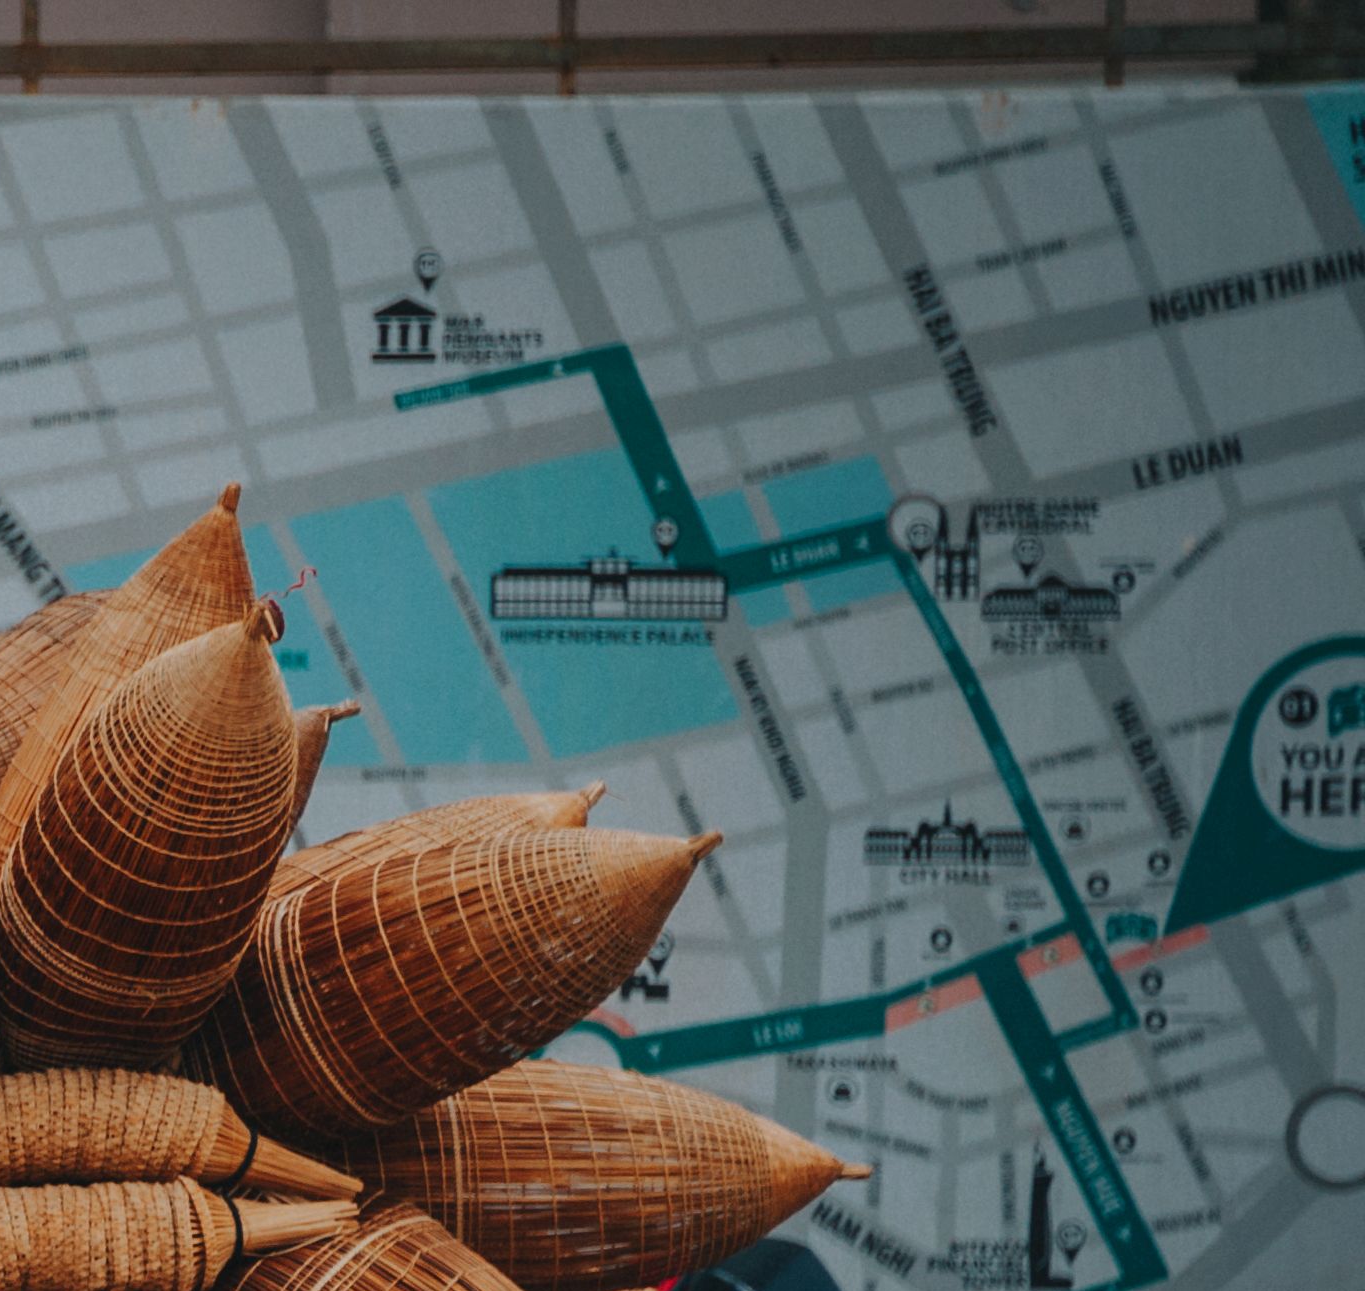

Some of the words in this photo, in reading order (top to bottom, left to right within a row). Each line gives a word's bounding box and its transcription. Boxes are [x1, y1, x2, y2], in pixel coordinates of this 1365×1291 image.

[1149, 272, 1258, 327] NGUYEN
[1260, 260, 1308, 300] THI
[1132, 453, 1163, 490] LE
[1168, 432, 1244, 481] DUAN
[1281, 741, 1344, 771] YOU
[812, 1201, 862, 1247] HAM
[862, 1231, 917, 1279] NGHI
